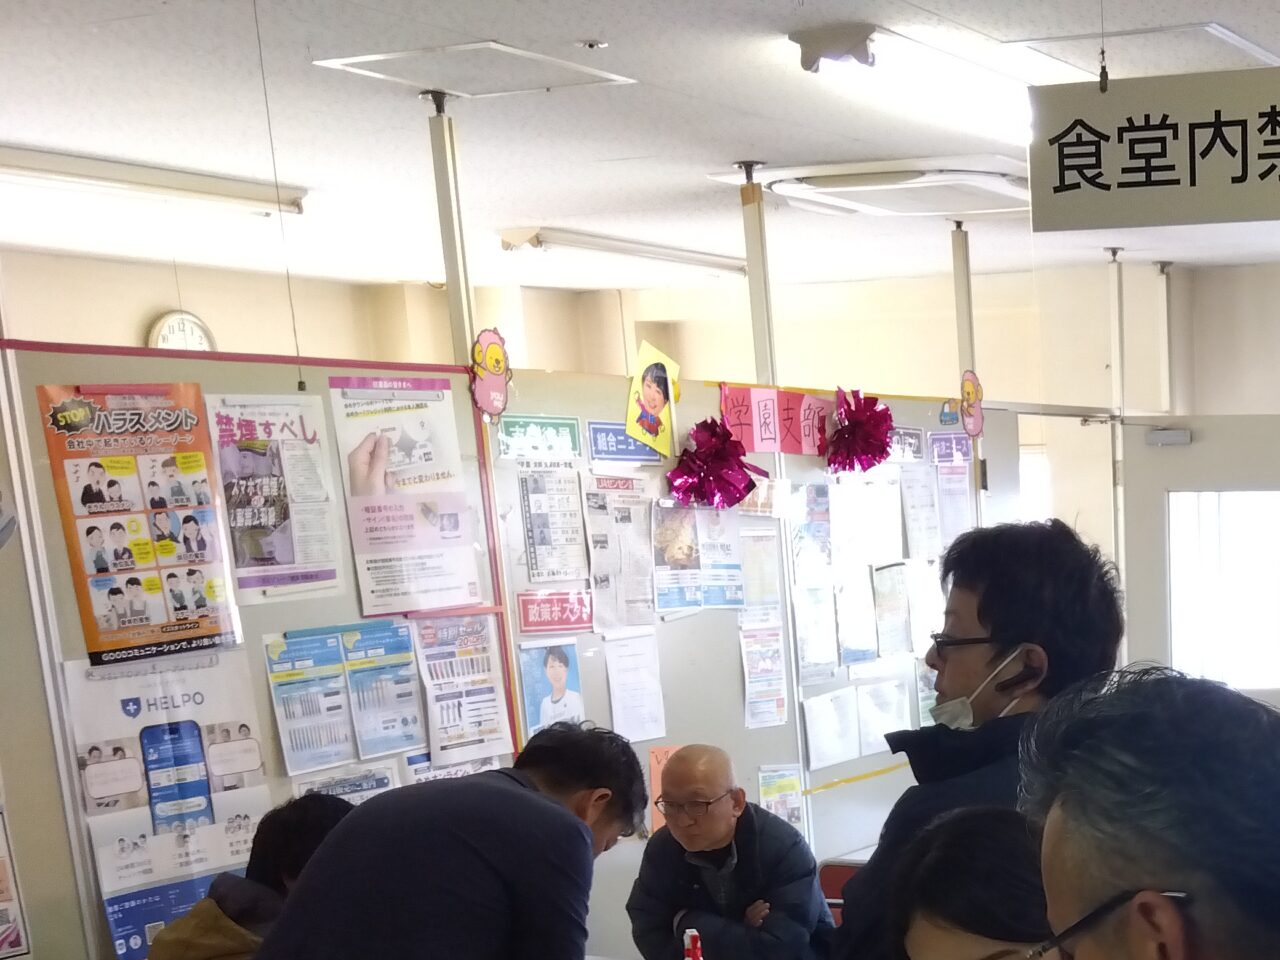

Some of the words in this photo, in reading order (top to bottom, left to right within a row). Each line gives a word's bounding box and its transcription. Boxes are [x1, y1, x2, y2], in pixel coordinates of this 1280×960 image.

[93, 408, 199, 433] ハラスメント
[214, 411, 320, 448] 禁煙すべし
[728, 397, 825, 448] 学園支部
[597, 431, 651, 452] 組合ニュー
[527, 602, 592, 623] 政策ポスタ
[146, 691, 205, 713] HELPO
